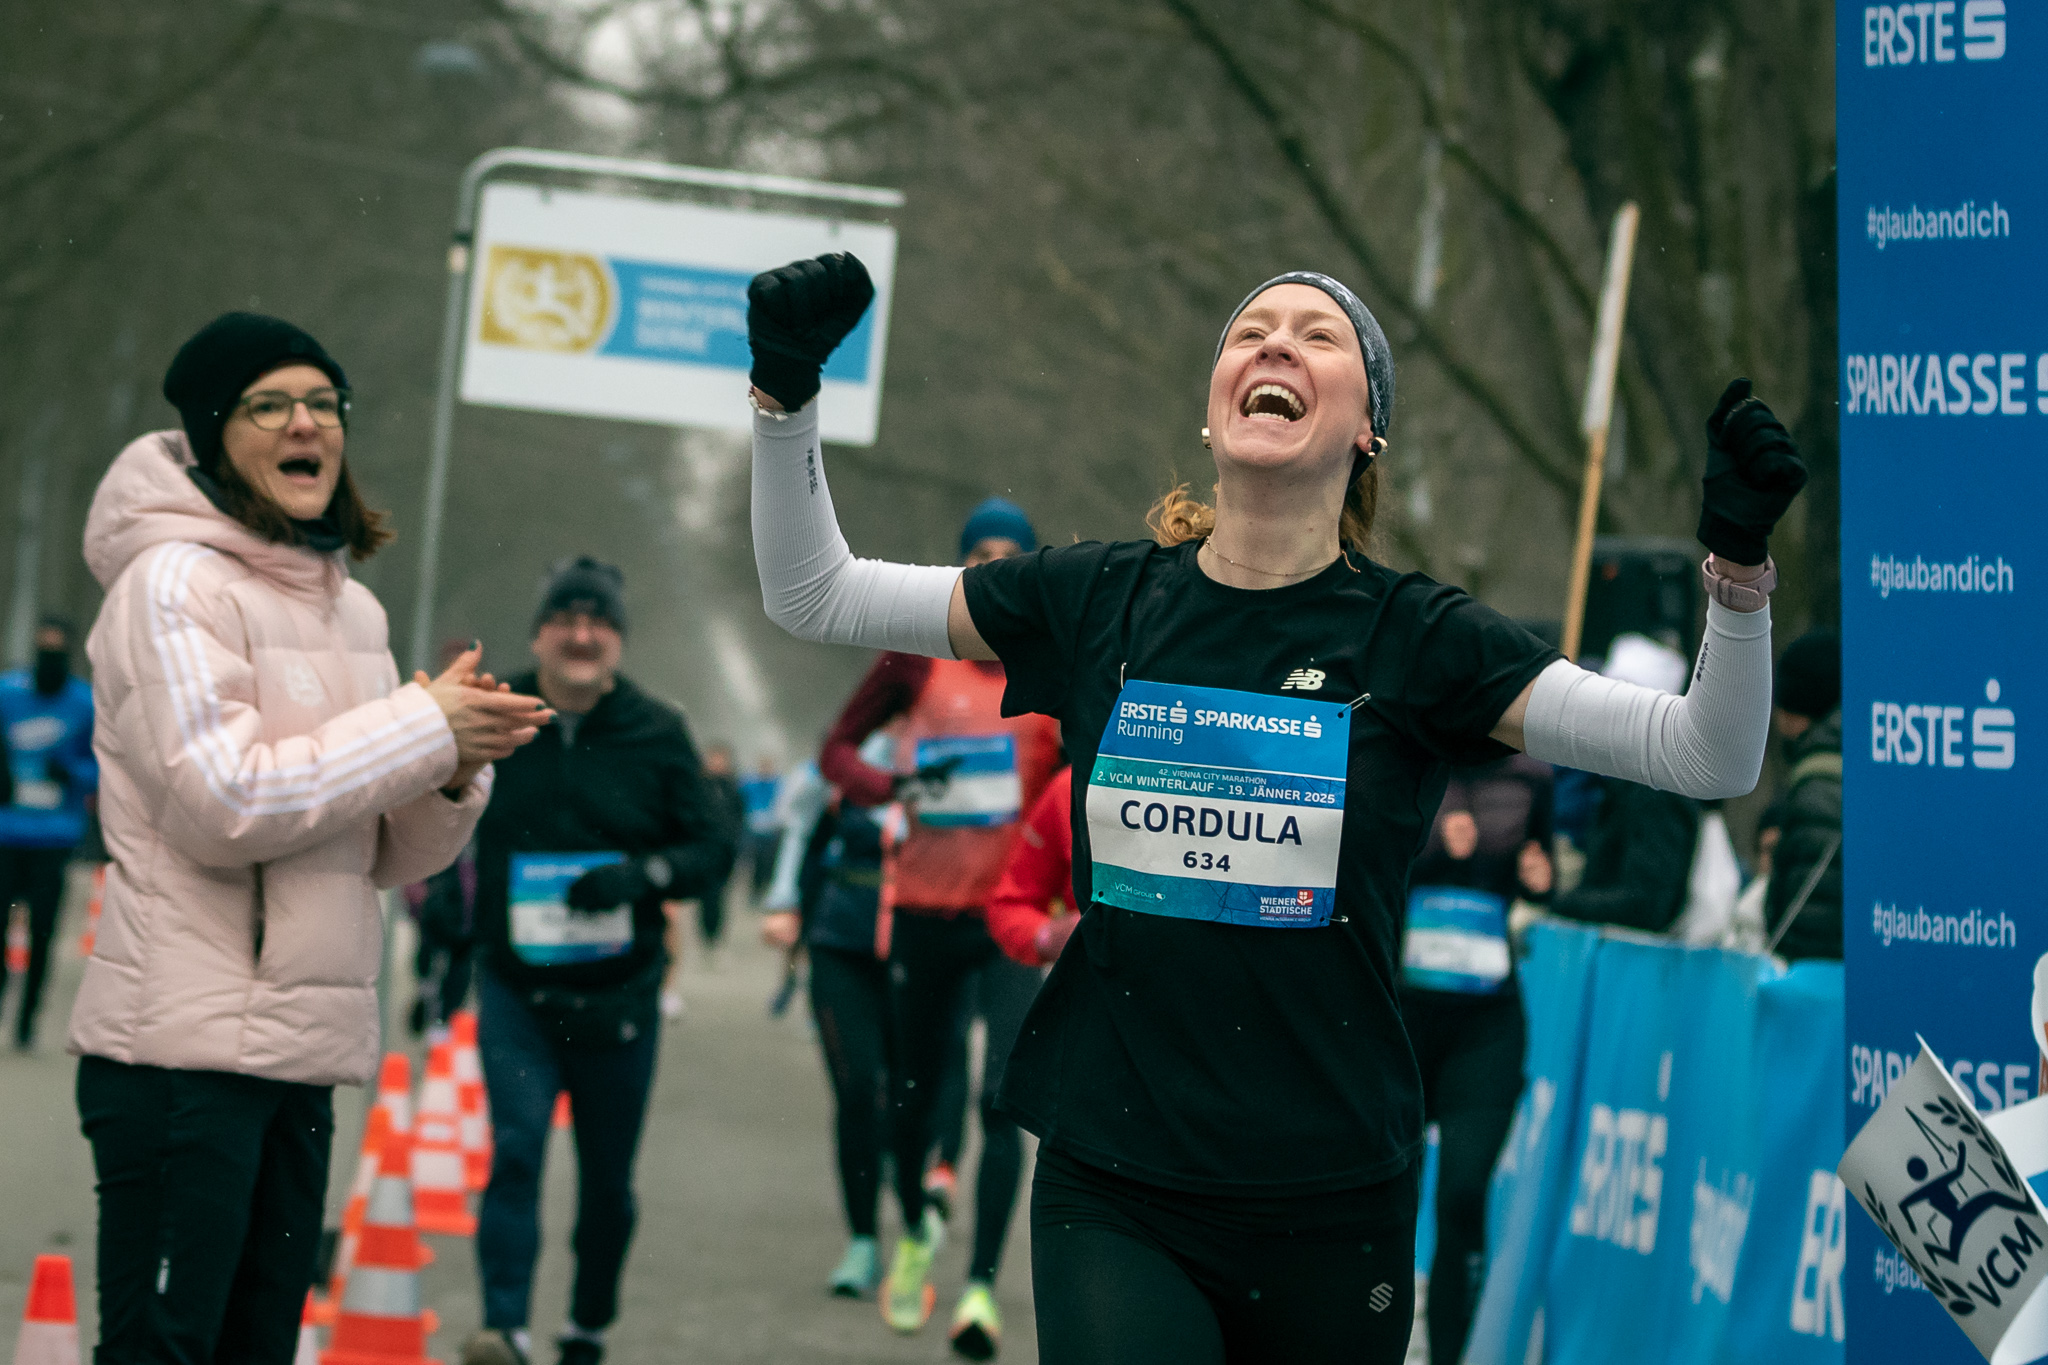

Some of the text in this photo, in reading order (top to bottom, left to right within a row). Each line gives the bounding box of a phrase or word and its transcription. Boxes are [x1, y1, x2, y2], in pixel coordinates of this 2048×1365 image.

[1864, 2, 1956, 67] ERSTE
[1867, 200, 2010, 251] #glaubandich
[1847, 353, 2028, 415] SPARKASSE
[1871, 553, 2014, 599] #glaubandich
[1117, 720, 1184, 744] Running
[1120, 701, 1167, 723] ERSTE
[1194, 709, 1301, 736] SPARKASSE
[1871, 701, 1965, 768] ERSTE
[1097, 770, 1106, 781] 2.
[1109, 772, 1133, 784] VCM
[1136, 775, 1215, 793] WINTERLAUF
[1228, 784, 1246, 796] 19.
[1249, 785, 1301, 801] JÄNNER
[1304, 791, 1336, 804] 2025
[1158, 768, 1267, 785] 42. VIENNA CITY MARATHON
[1120, 800, 1303, 846] CORDULA
[1182, 850, 1231, 872] 634
[1114, 881, 1133, 894] VCM
[1260, 896, 1297, 906] WIENER
[1873, 901, 2016, 948] #glaubandich
[1851, 1044, 2031, 1119] SPARSSE
[1967, 1215, 2043, 1308] VCM
